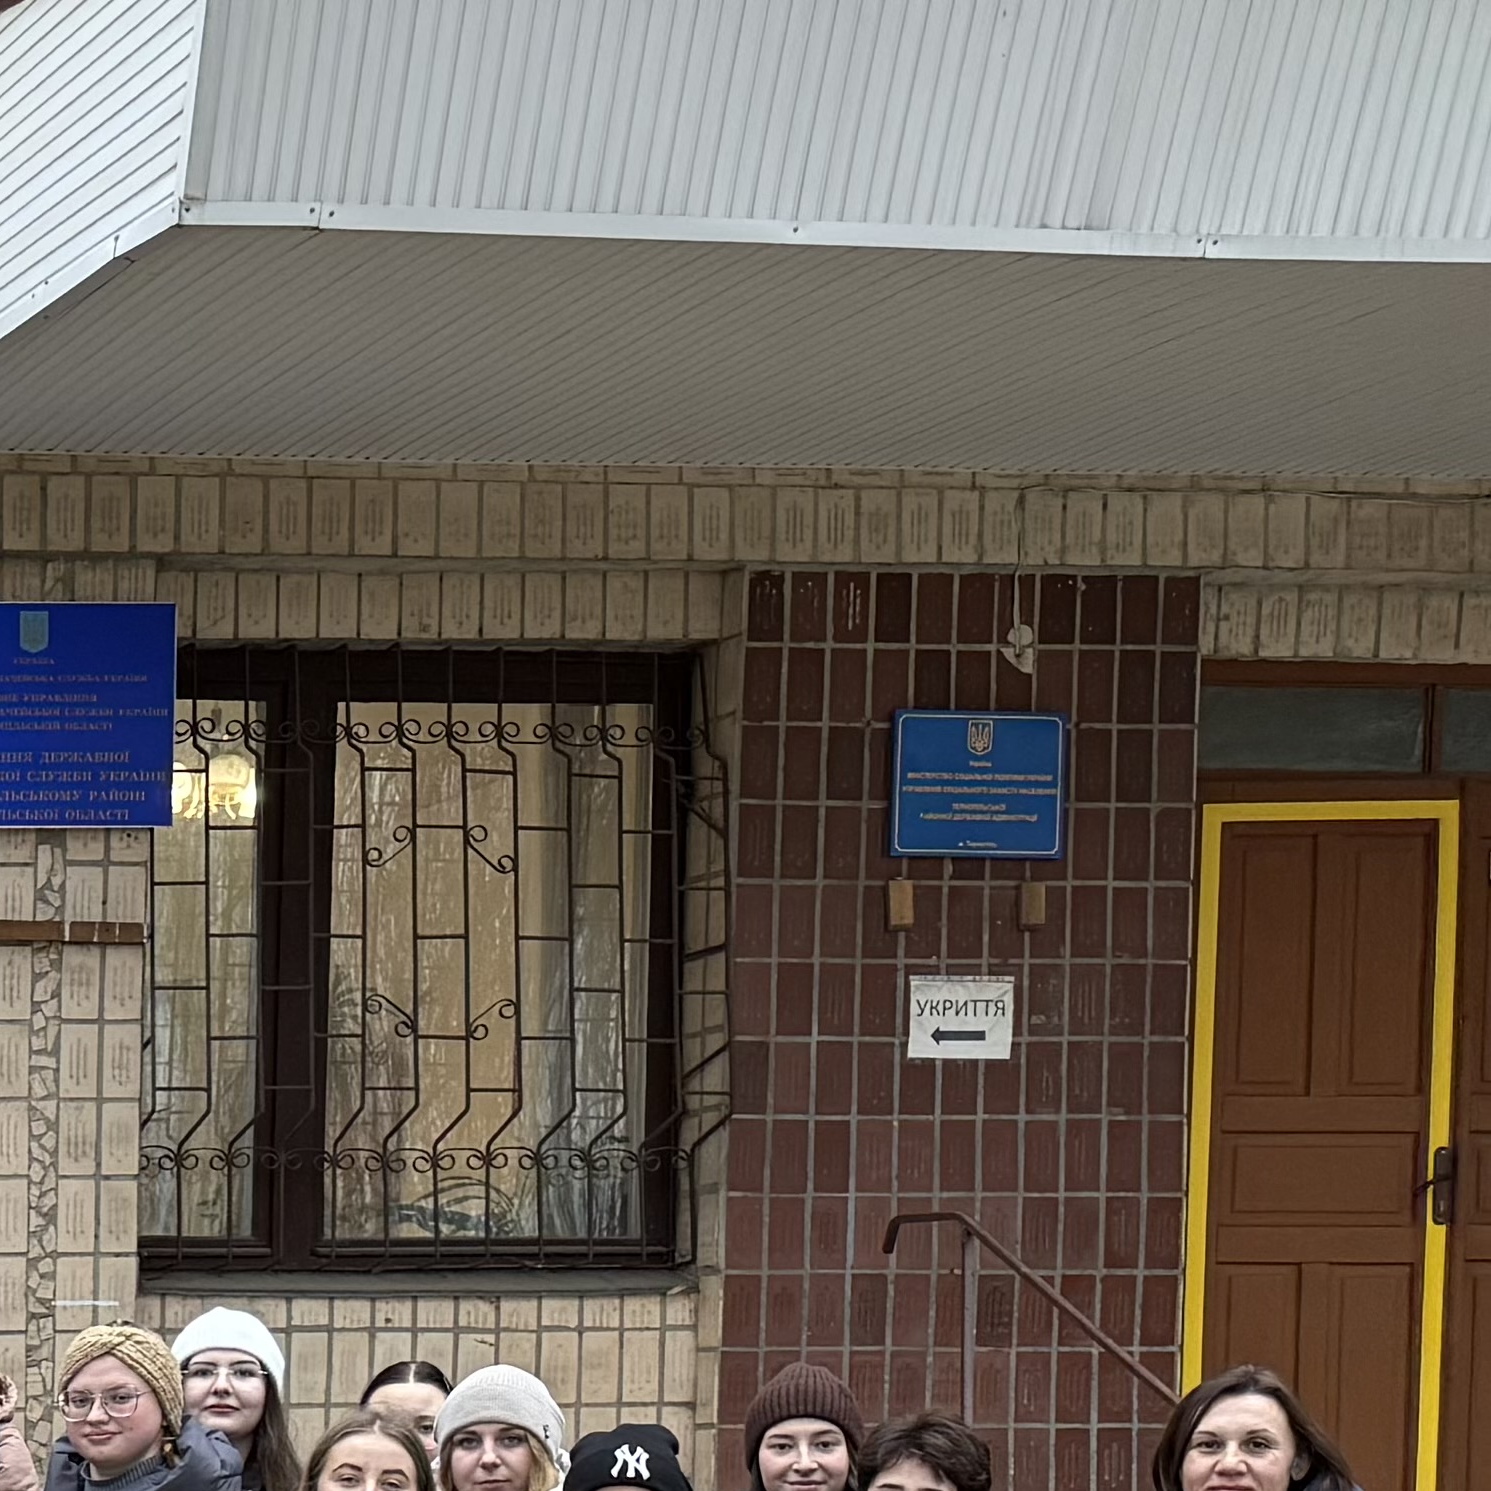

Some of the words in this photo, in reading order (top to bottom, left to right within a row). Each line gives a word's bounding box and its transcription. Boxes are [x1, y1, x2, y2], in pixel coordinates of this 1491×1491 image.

[39, 750, 130, 764] ДЕРЖАВНОЇ
[27, 770, 92, 782] СЛУЖБИ
[89, 788, 146, 801] РАЙОНІ
[65, 808, 130, 821] ОБЛАСТІ
[916, 999, 1006, 1017] УКРИТТЯ
